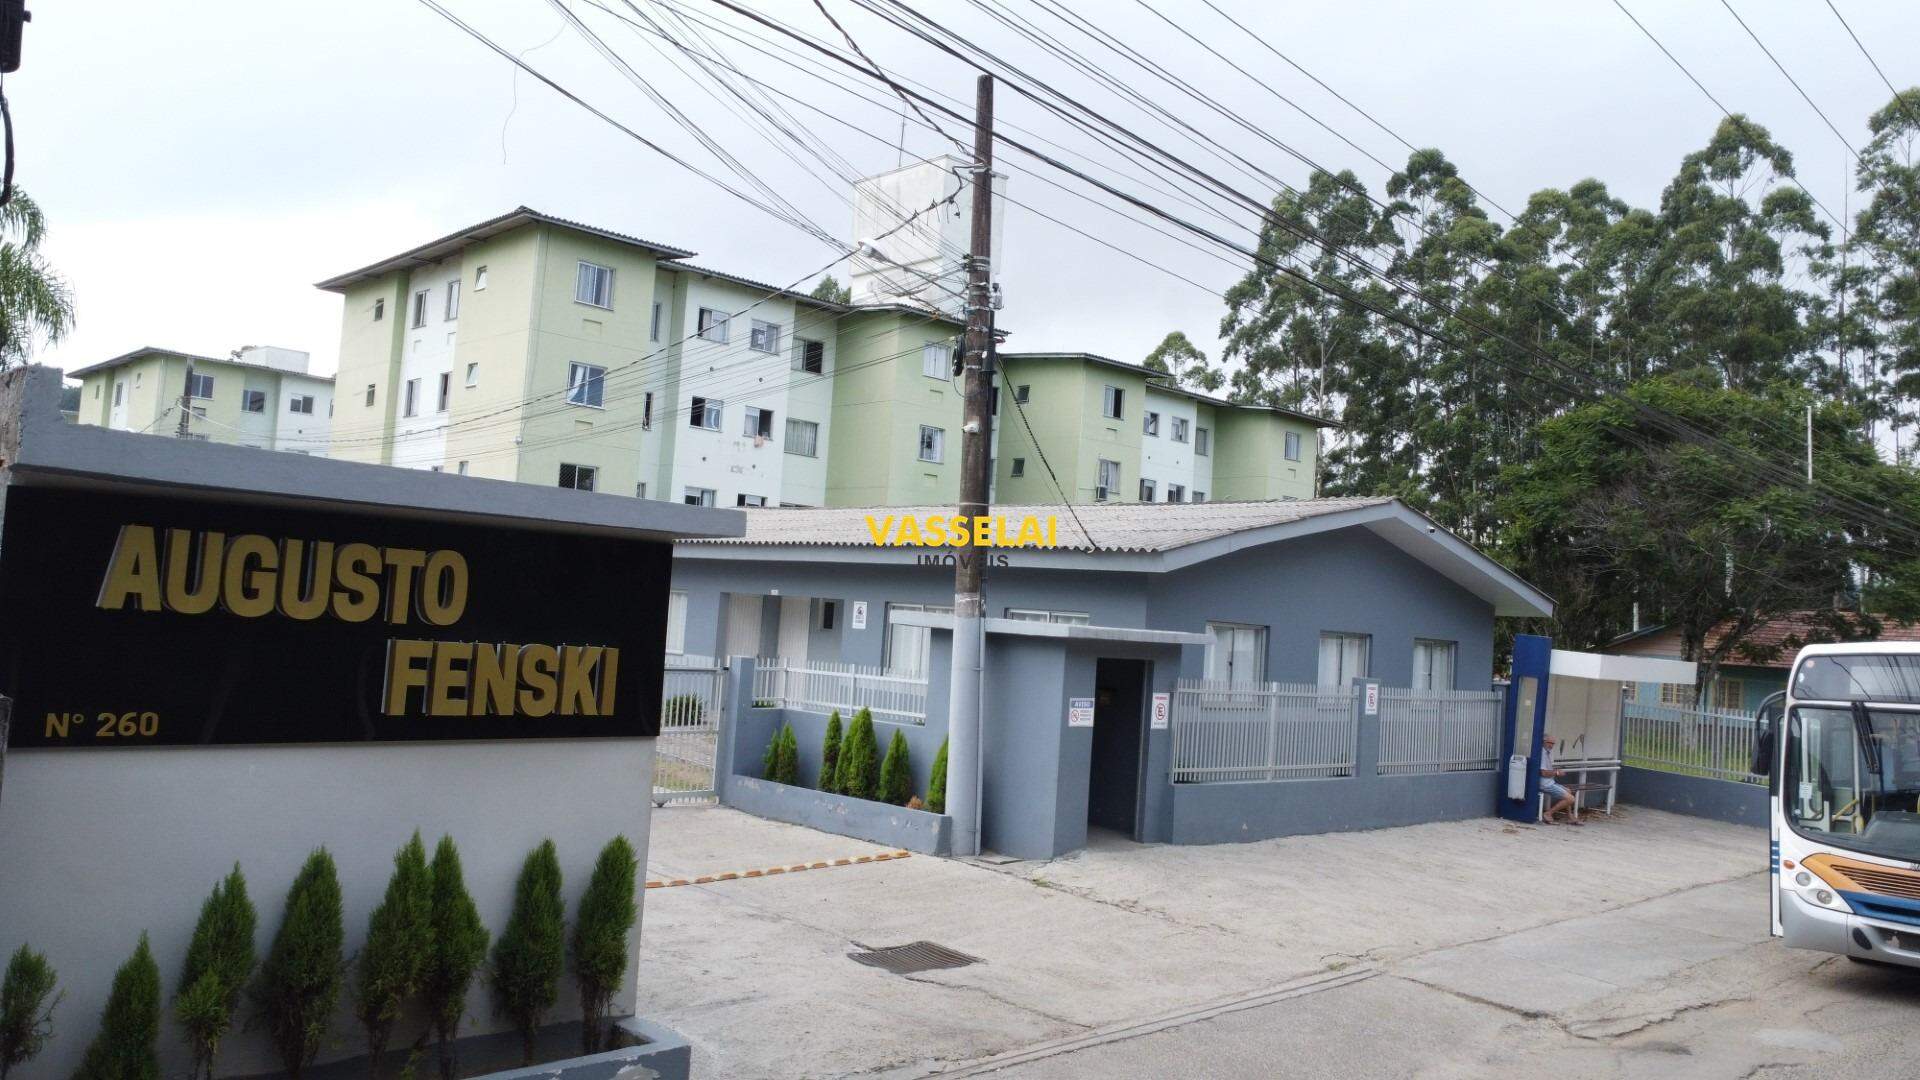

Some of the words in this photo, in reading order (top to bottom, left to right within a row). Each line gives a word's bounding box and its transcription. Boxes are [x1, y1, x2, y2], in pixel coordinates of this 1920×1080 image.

[96, 525, 469, 626] AUGUSTO
[381, 639, 619, 717] FENSKI
[96, 712, 159, 736] 260
